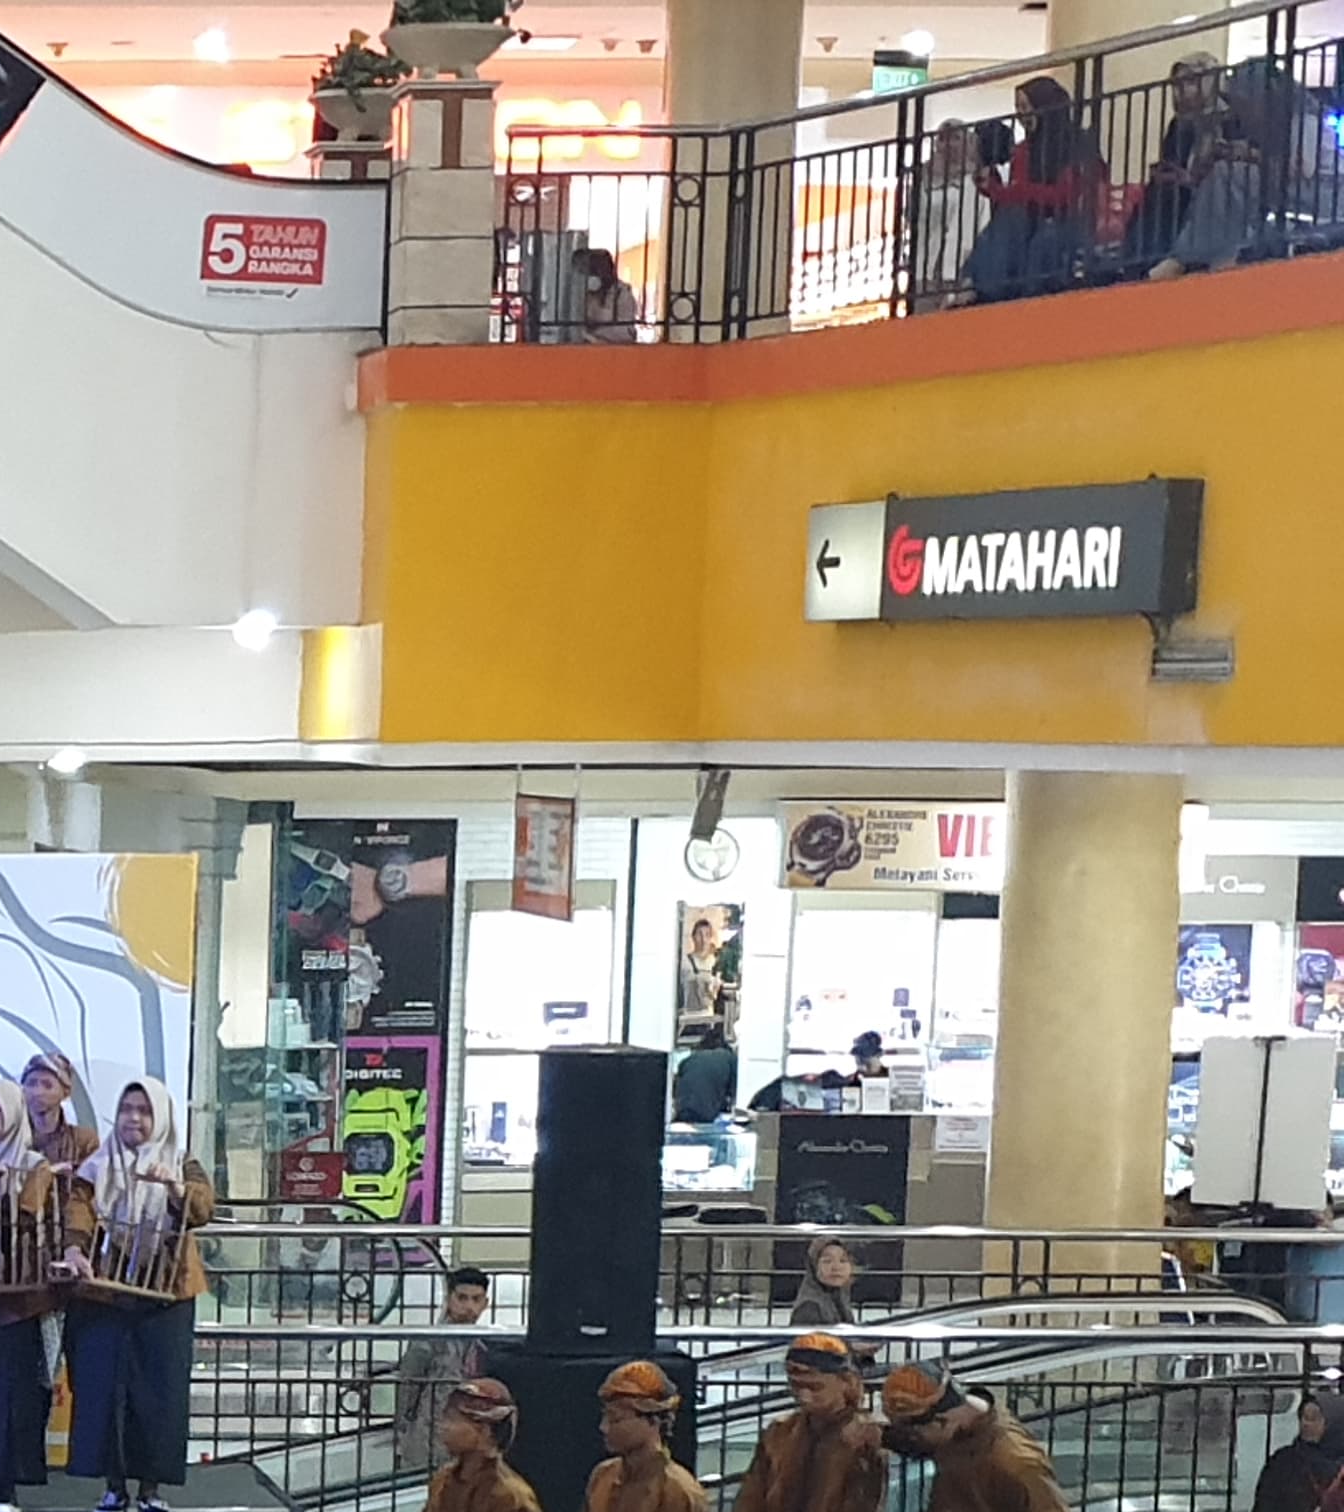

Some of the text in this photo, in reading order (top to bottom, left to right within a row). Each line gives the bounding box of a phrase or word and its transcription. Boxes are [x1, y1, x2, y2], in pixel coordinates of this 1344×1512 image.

[208, 222, 246, 275] 5
[248, 244, 318, 261] GARANSI
[247, 260, 314, 276] RANGKA
[923, 526, 1122, 596] MATAHARI
